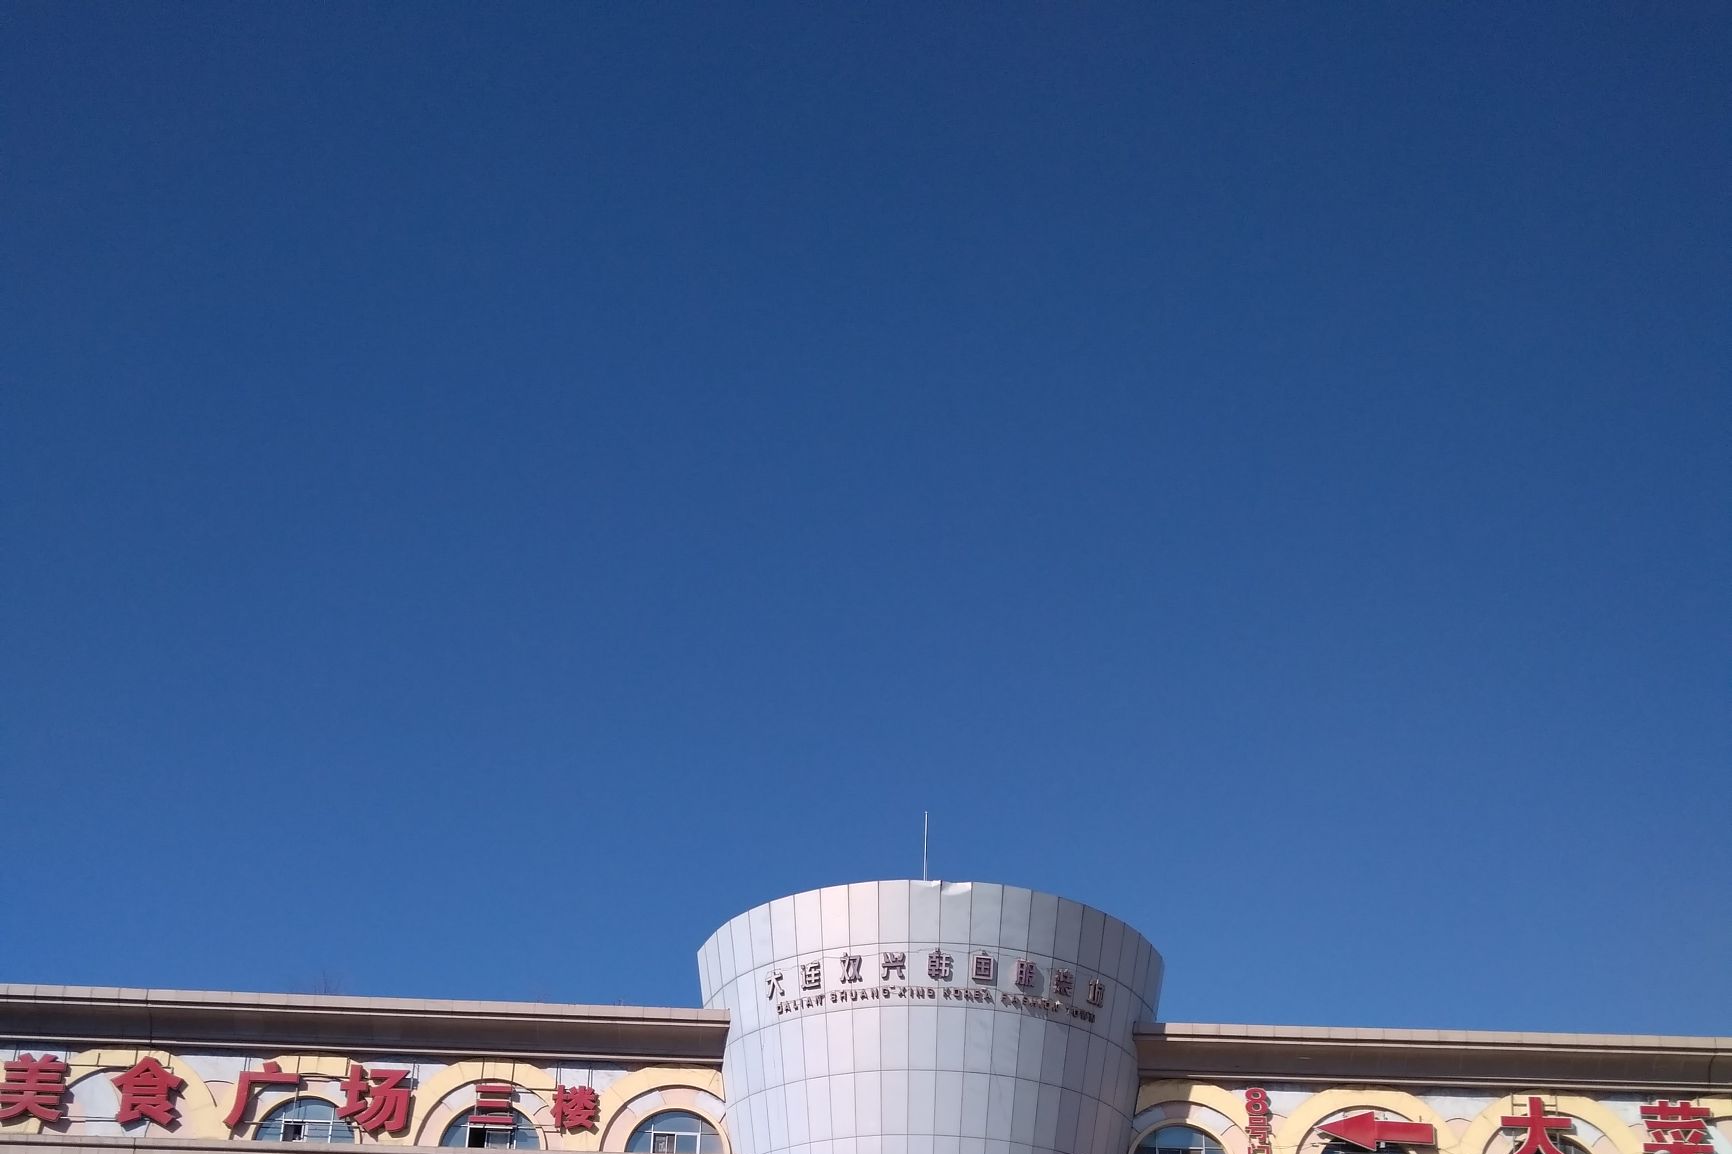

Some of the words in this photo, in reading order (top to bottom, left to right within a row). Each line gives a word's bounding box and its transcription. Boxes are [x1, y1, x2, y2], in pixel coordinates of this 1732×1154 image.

[0, 1053, 415, 1134] 美食广场
[467, 1083, 600, 1130] 三楼
